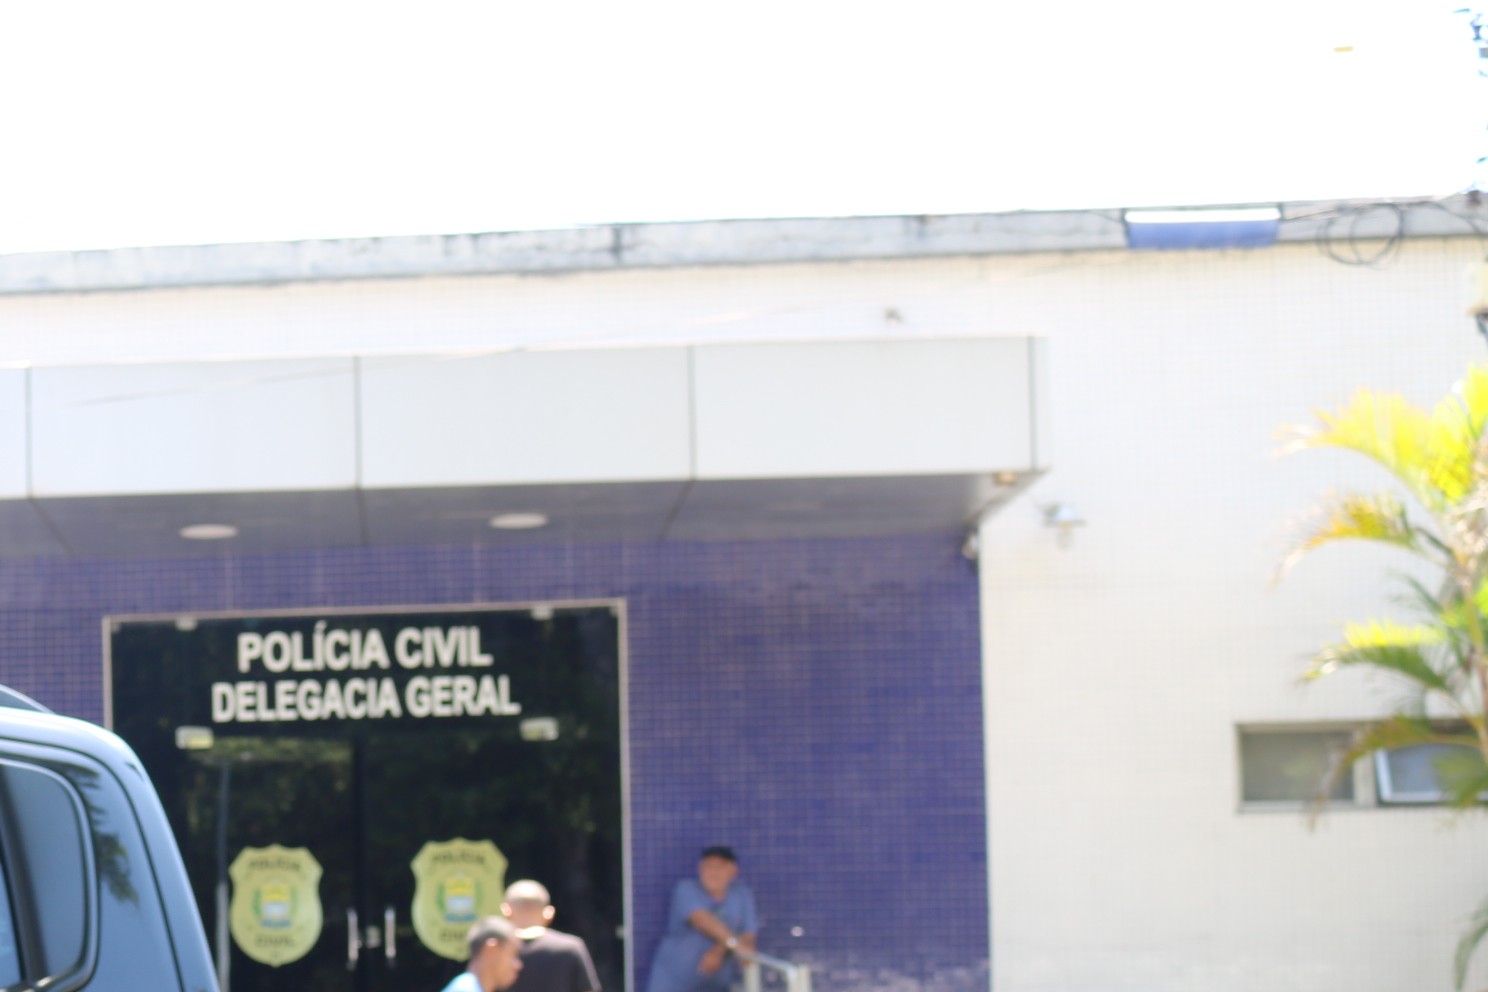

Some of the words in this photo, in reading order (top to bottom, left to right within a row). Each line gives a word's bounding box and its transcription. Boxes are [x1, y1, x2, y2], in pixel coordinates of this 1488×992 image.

[237, 621, 389, 673] POLÍCIA
[395, 626, 493, 668] CIVIL
[212, 678, 401, 723] DELEGACIA
[405, 674, 521, 717] GERAL
